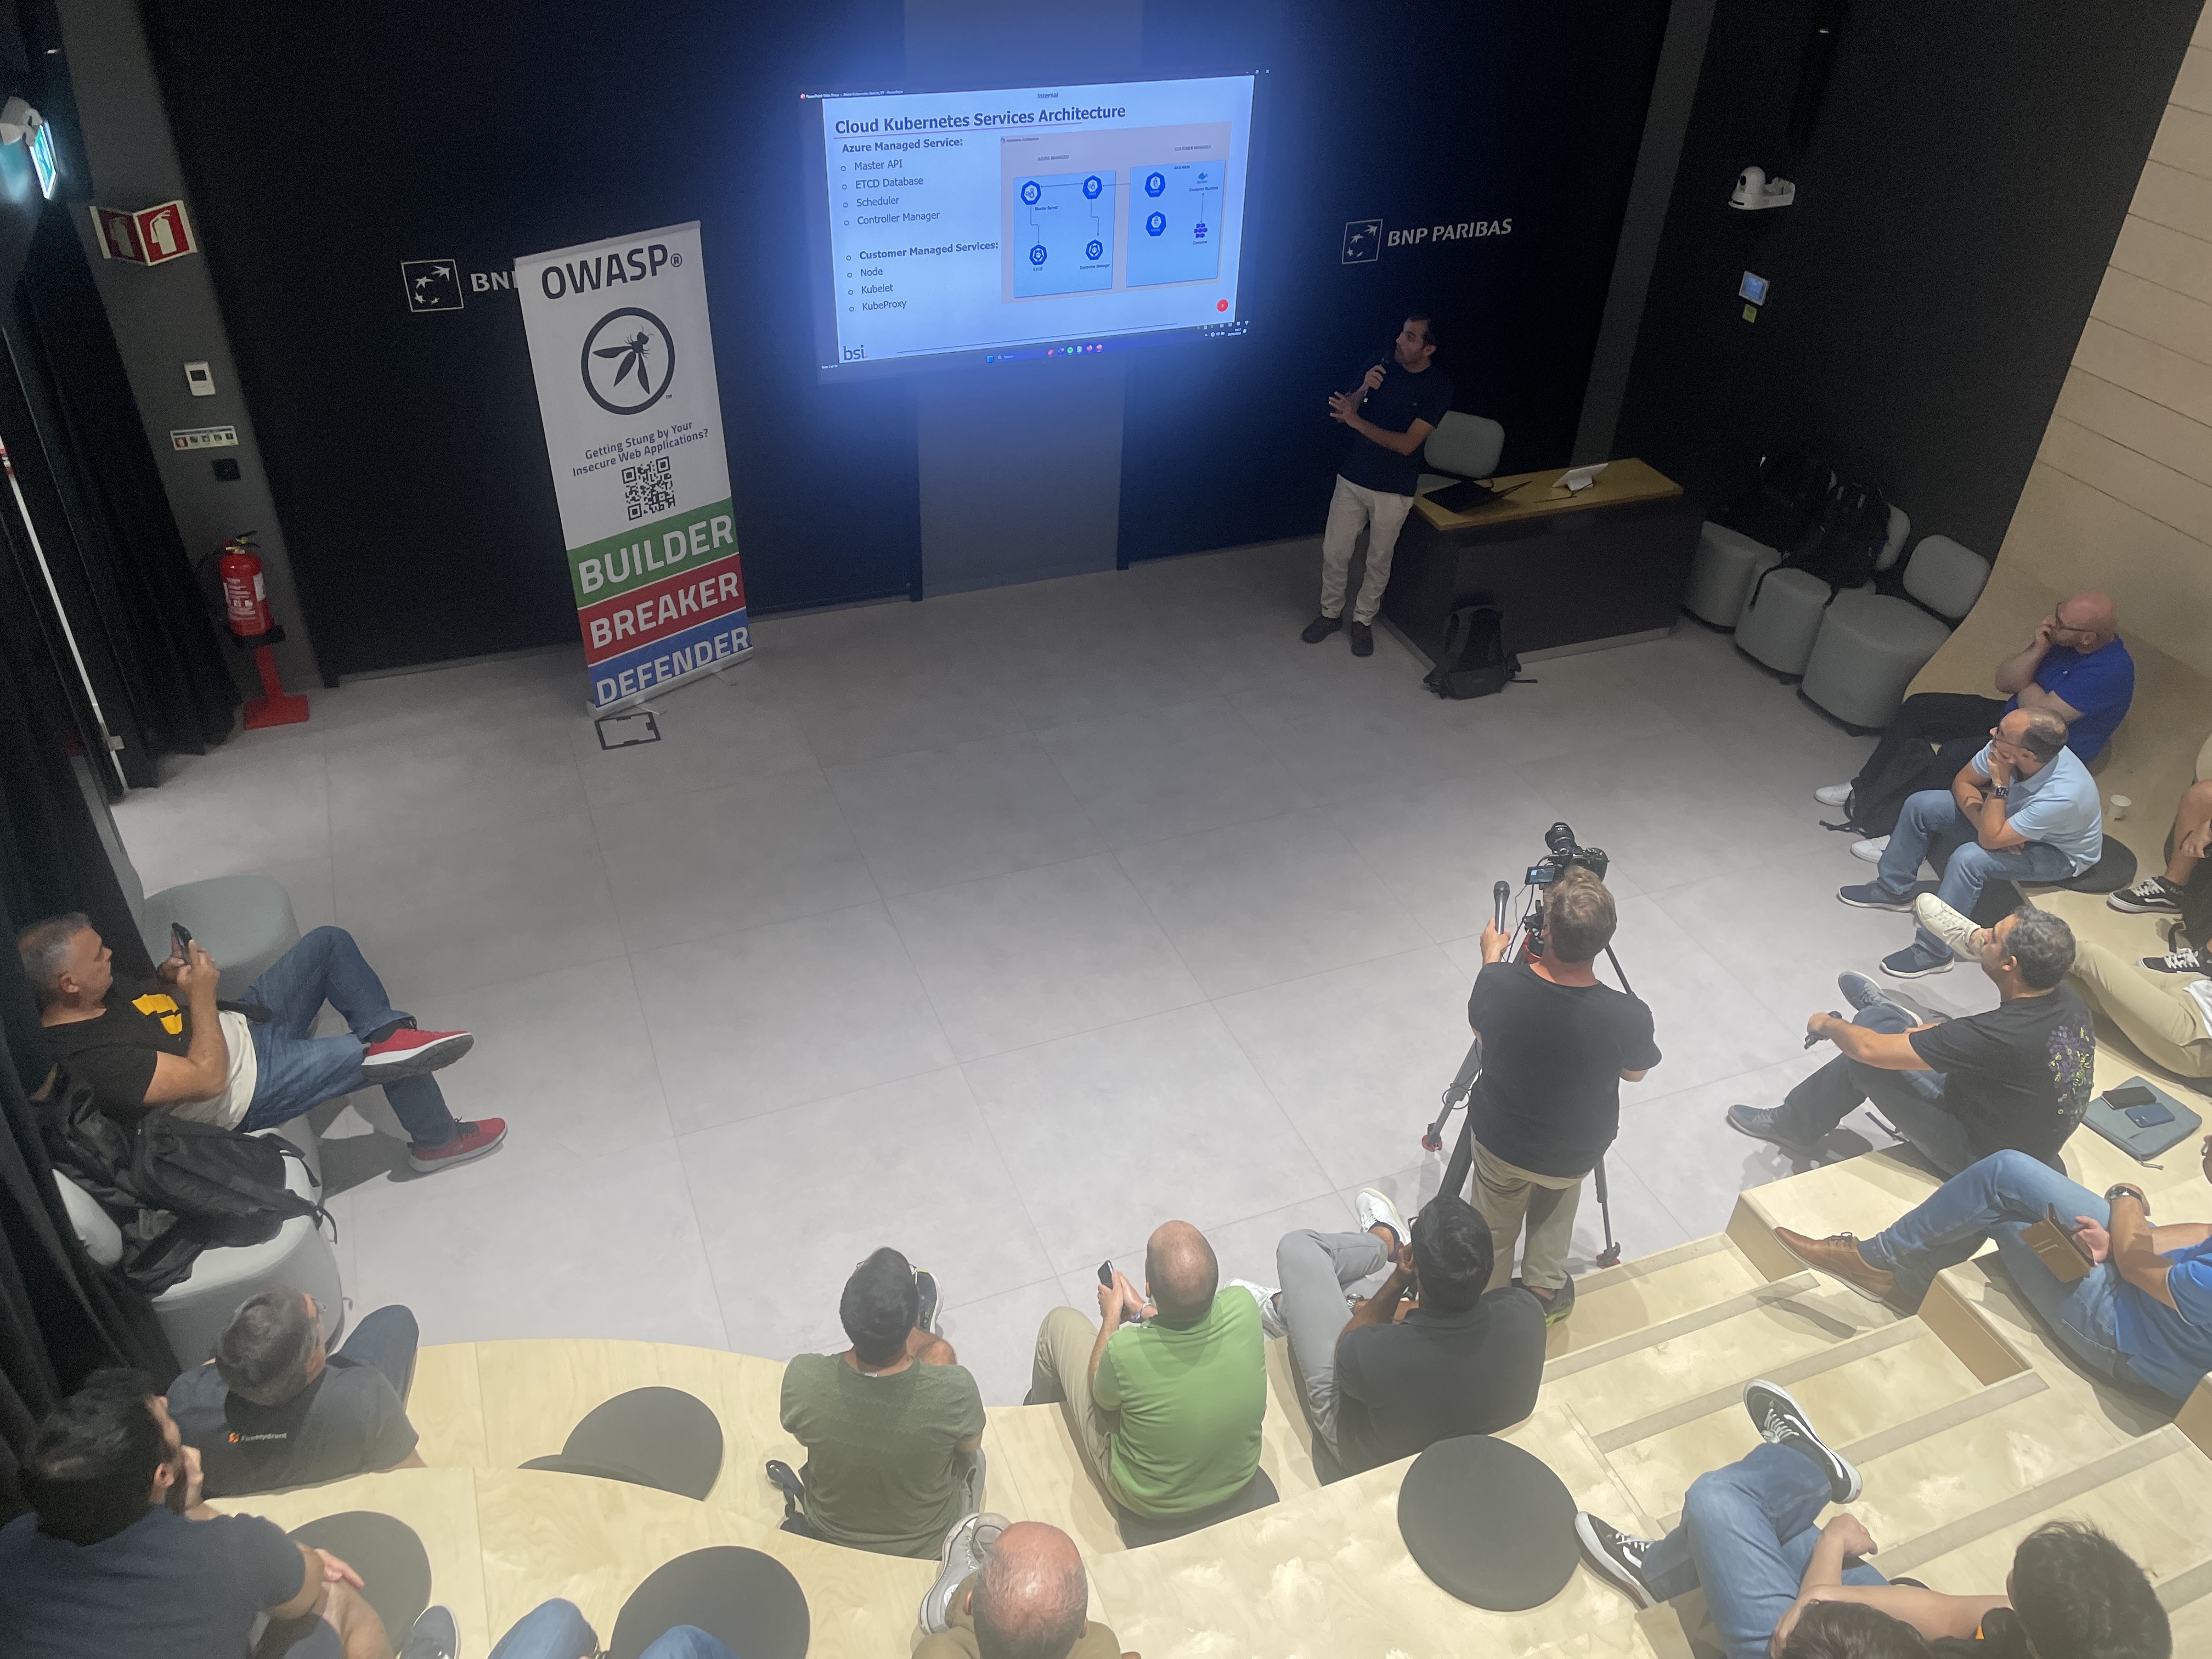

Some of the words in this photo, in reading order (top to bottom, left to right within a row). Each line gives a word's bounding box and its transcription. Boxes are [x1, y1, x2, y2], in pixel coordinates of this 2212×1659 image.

[835, 119, 878, 134] Cloud
[884, 112, 969, 131] Kubernetes
[974, 110, 1035, 126] Services
[1039, 105, 1126, 123] Architecture
[842, 143, 872, 153] Azure
[874, 139, 920, 151] Managed
[923, 138, 963, 148] Service:
[855, 161, 884, 171] Master
[887, 159, 902, 169] API
[855, 179, 880, 189] ETCD
[883, 177, 924, 187] Database
[856, 196, 900, 207] Scheduler
[857, 213, 900, 225] Controller
[902, 211, 940, 223] Manager
[1387, 228, 1427, 246] BNP
[1432, 218, 1512, 242] PARIBAS
[859, 249, 907, 260] Customer
[910, 244, 953, 256] Managed
[956, 241, 998, 252] Services:
[860, 267, 883, 277] Node
[861, 284, 894, 294] Kubelet
[862, 300, 907, 312] KubeProxy
[585, 443, 623, 459] Getting
[625, 433, 655, 448] Stung
[657, 430, 669, 439] by
[671, 422, 692, 434] Your
[573, 457, 616, 477] Insecure
[619, 449, 641, 462] Web
[644, 428, 708, 455] Applications?
[578, 515, 734, 594] BUILDER
[590, 572, 739, 649] BREAKER
[596, 627, 749, 705] DEFENDER
